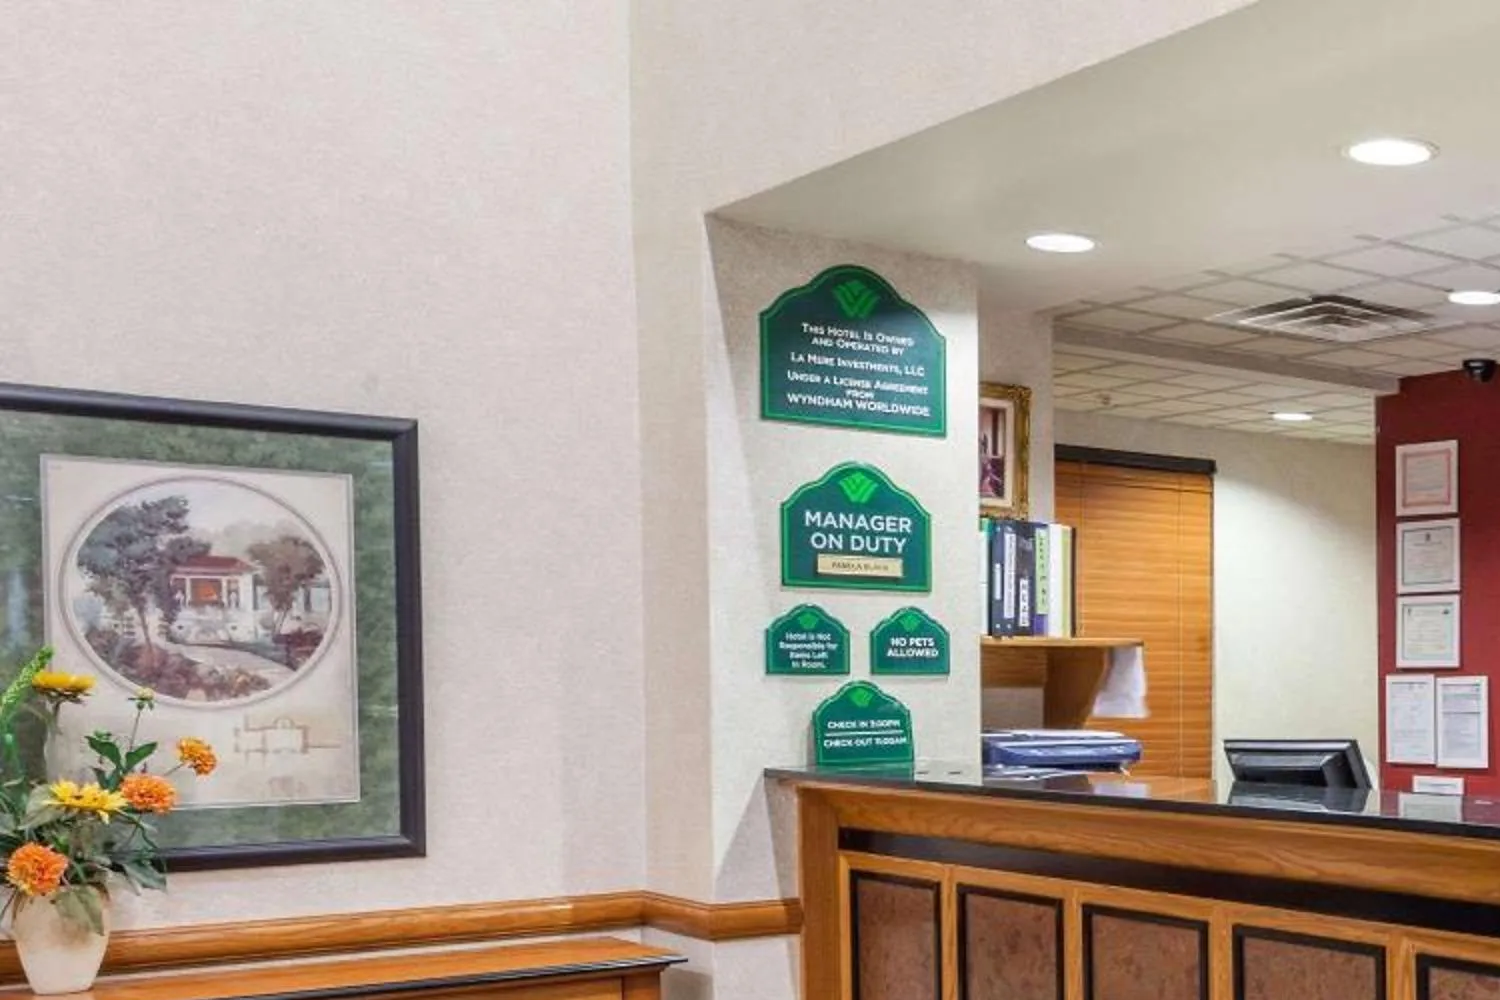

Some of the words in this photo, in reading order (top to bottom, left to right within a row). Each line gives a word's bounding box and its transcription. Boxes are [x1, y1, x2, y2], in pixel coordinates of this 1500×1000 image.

[801, 323, 825, 335] THIS
[827, 326, 860, 340] HOTEL
[836, 338, 889, 354] OPERATED
[904, 366, 925, 377] LLC
[787, 393, 853, 409] WYNDHAM
[855, 400, 931, 418] WORLDWIDE
[804, 509, 912, 533] MANAGER
[810, 531, 843, 550] ON
[850, 535, 907, 554] DUTY
[891, 637, 907, 647] NO
[909, 637, 935, 647] PETS
[887, 647, 939, 658] ALLOWED
[827, 720, 857, 729] CHECK
[823, 738, 854, 748] CHECK
[855, 738, 873, 747] OUT
